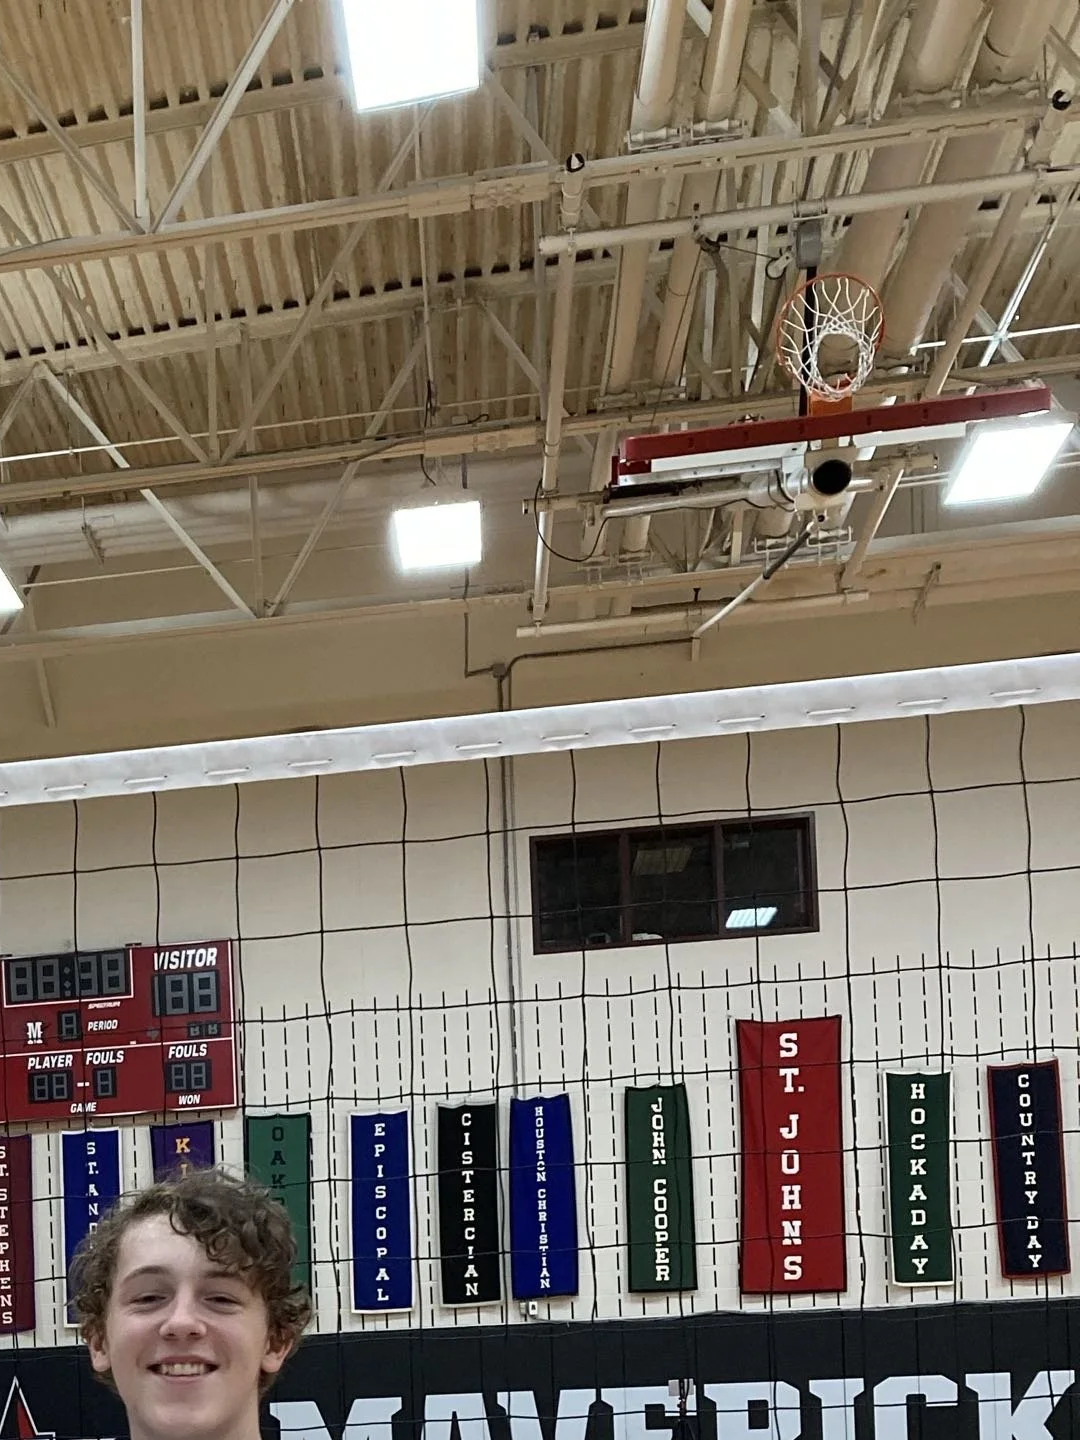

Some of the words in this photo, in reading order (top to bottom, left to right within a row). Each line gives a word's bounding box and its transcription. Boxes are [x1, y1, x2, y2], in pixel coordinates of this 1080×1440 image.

[153, 947, 218, 971] VISITOR
[87, 1019, 119, 1032] PERIOD
[168, 1043, 208, 1059] FOULS
[27, 1054, 74, 1070] PLAYER
[85, 1050, 125, 1066] FOULS
[779, 1032, 805, 1093] ST.
[70, 1101, 97, 1114] GAME
[178, 1094, 201, 1105] WON
[650, 1097, 667, 1165] JOHN
[534, 1106, 547, 1182] HOUSTON
[1017, 1073, 1038, 1205] COUNTRY
[374, 1122, 391, 1302] EPISCOPAL
[461, 1112, 479, 1296] CISTERCIAN
[779, 1113, 803, 1281] JOHNS
[908, 1083, 929, 1275] HOCKADAY
[537, 1188, 551, 1289] CHRISTIAN
[653, 1178, 671, 1282] COOPER
[1026, 1215, 1043, 1268] DAY
